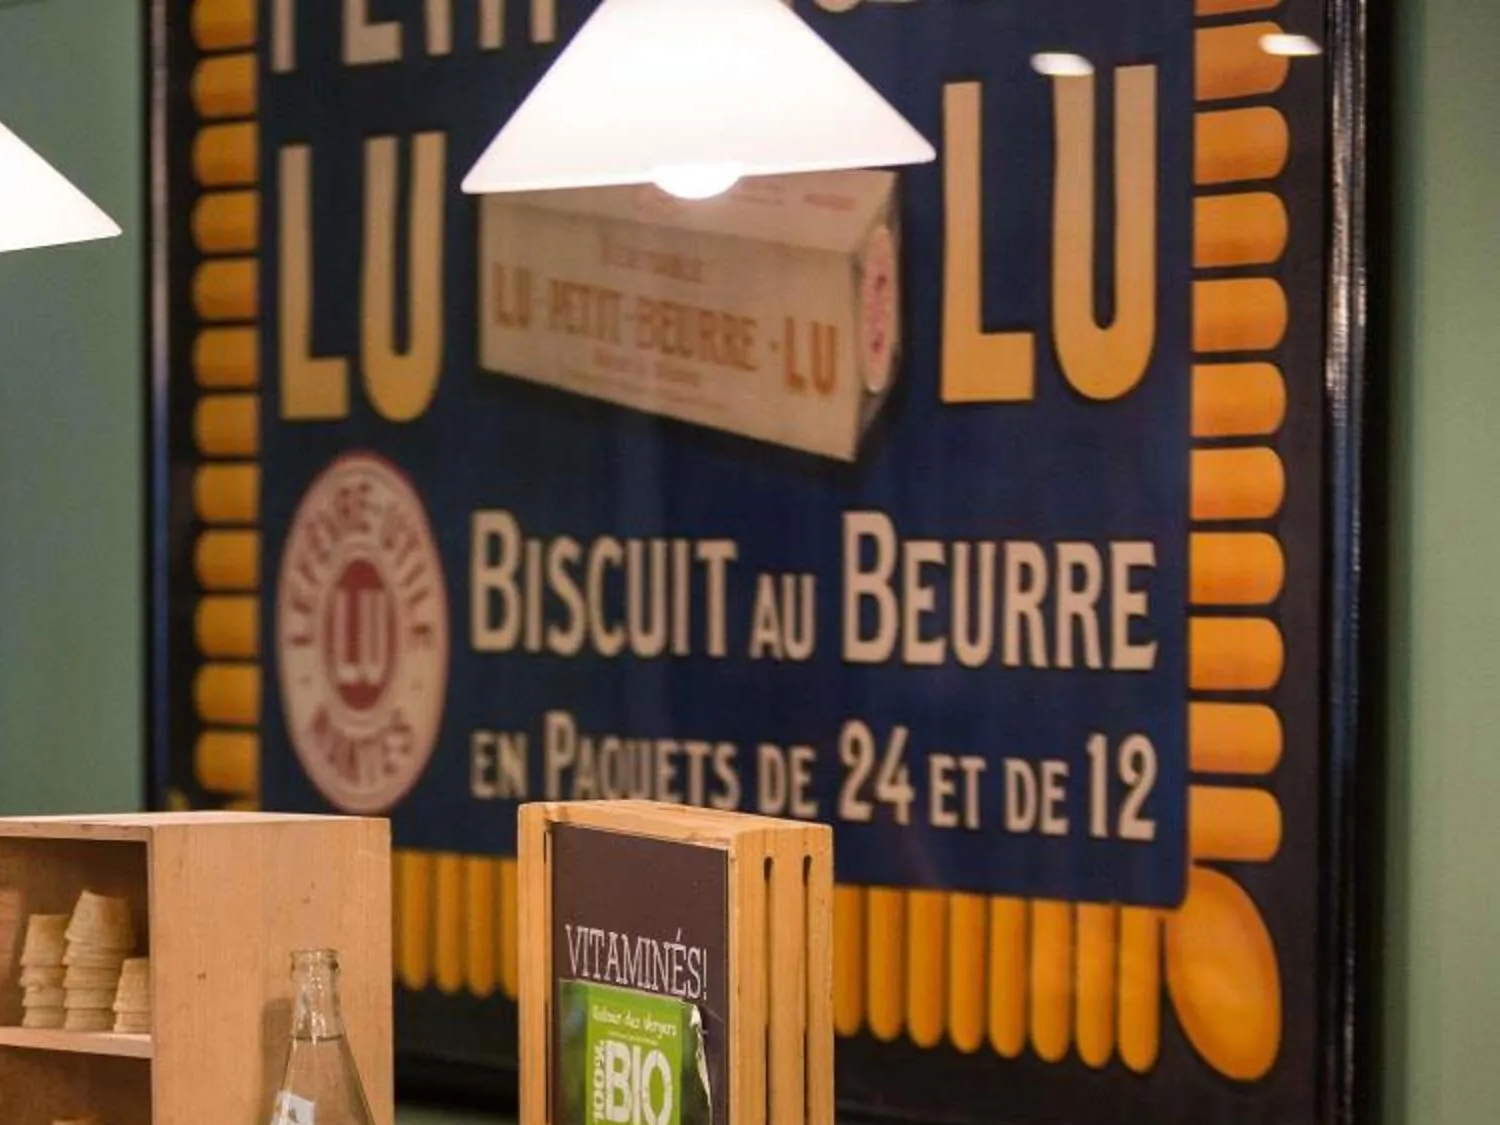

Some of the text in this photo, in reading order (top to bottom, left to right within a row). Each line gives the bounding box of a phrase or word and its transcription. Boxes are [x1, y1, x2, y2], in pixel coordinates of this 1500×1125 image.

[278, 131, 448, 423] LU
[940, 64, 1157, 404] LU
[836, 719, 916, 826] 24
[1086, 733, 1159, 841] 12
[565, 923, 708, 1001] VITAMINÉS!
